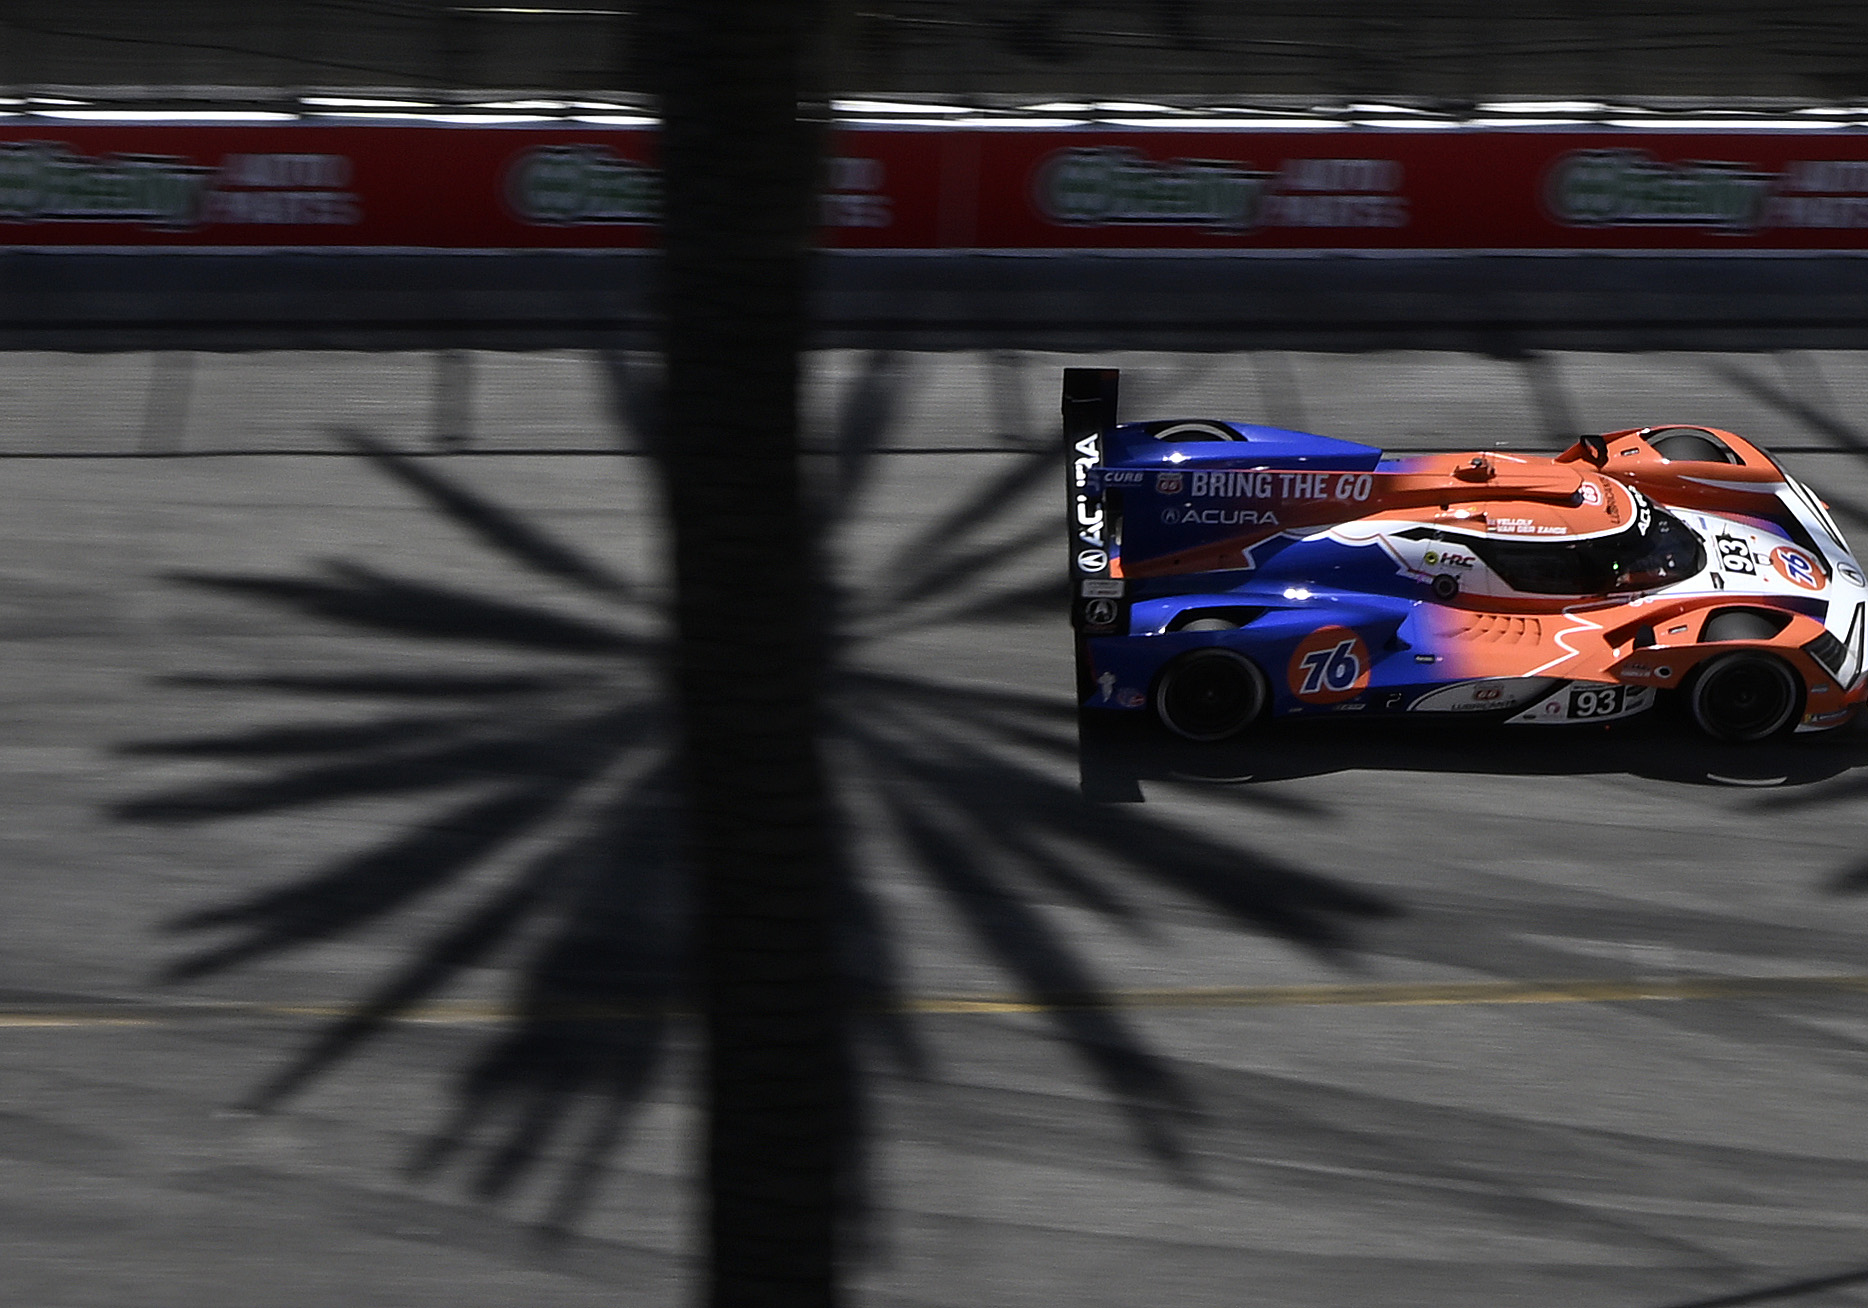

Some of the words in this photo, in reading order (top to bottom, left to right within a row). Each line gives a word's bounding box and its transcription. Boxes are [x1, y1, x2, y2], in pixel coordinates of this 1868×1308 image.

[1074, 432, 1104, 547] ACRA
[1104, 472, 1144, 482] CURB
[1160, 481, 1177, 491] 66
[1191, 473, 1272, 498] BRING
[1279, 474, 1329, 499] THE
[1335, 474, 1373, 501] GO
[1181, 509, 1279, 525] ACURA
[1440, 552, 1476, 567] HRC
[1717, 538, 1755, 573] 93
[1775, 546, 1818, 589] 76
[1299, 638, 1360, 695] 76
[1576, 689, 1617, 717] 93
